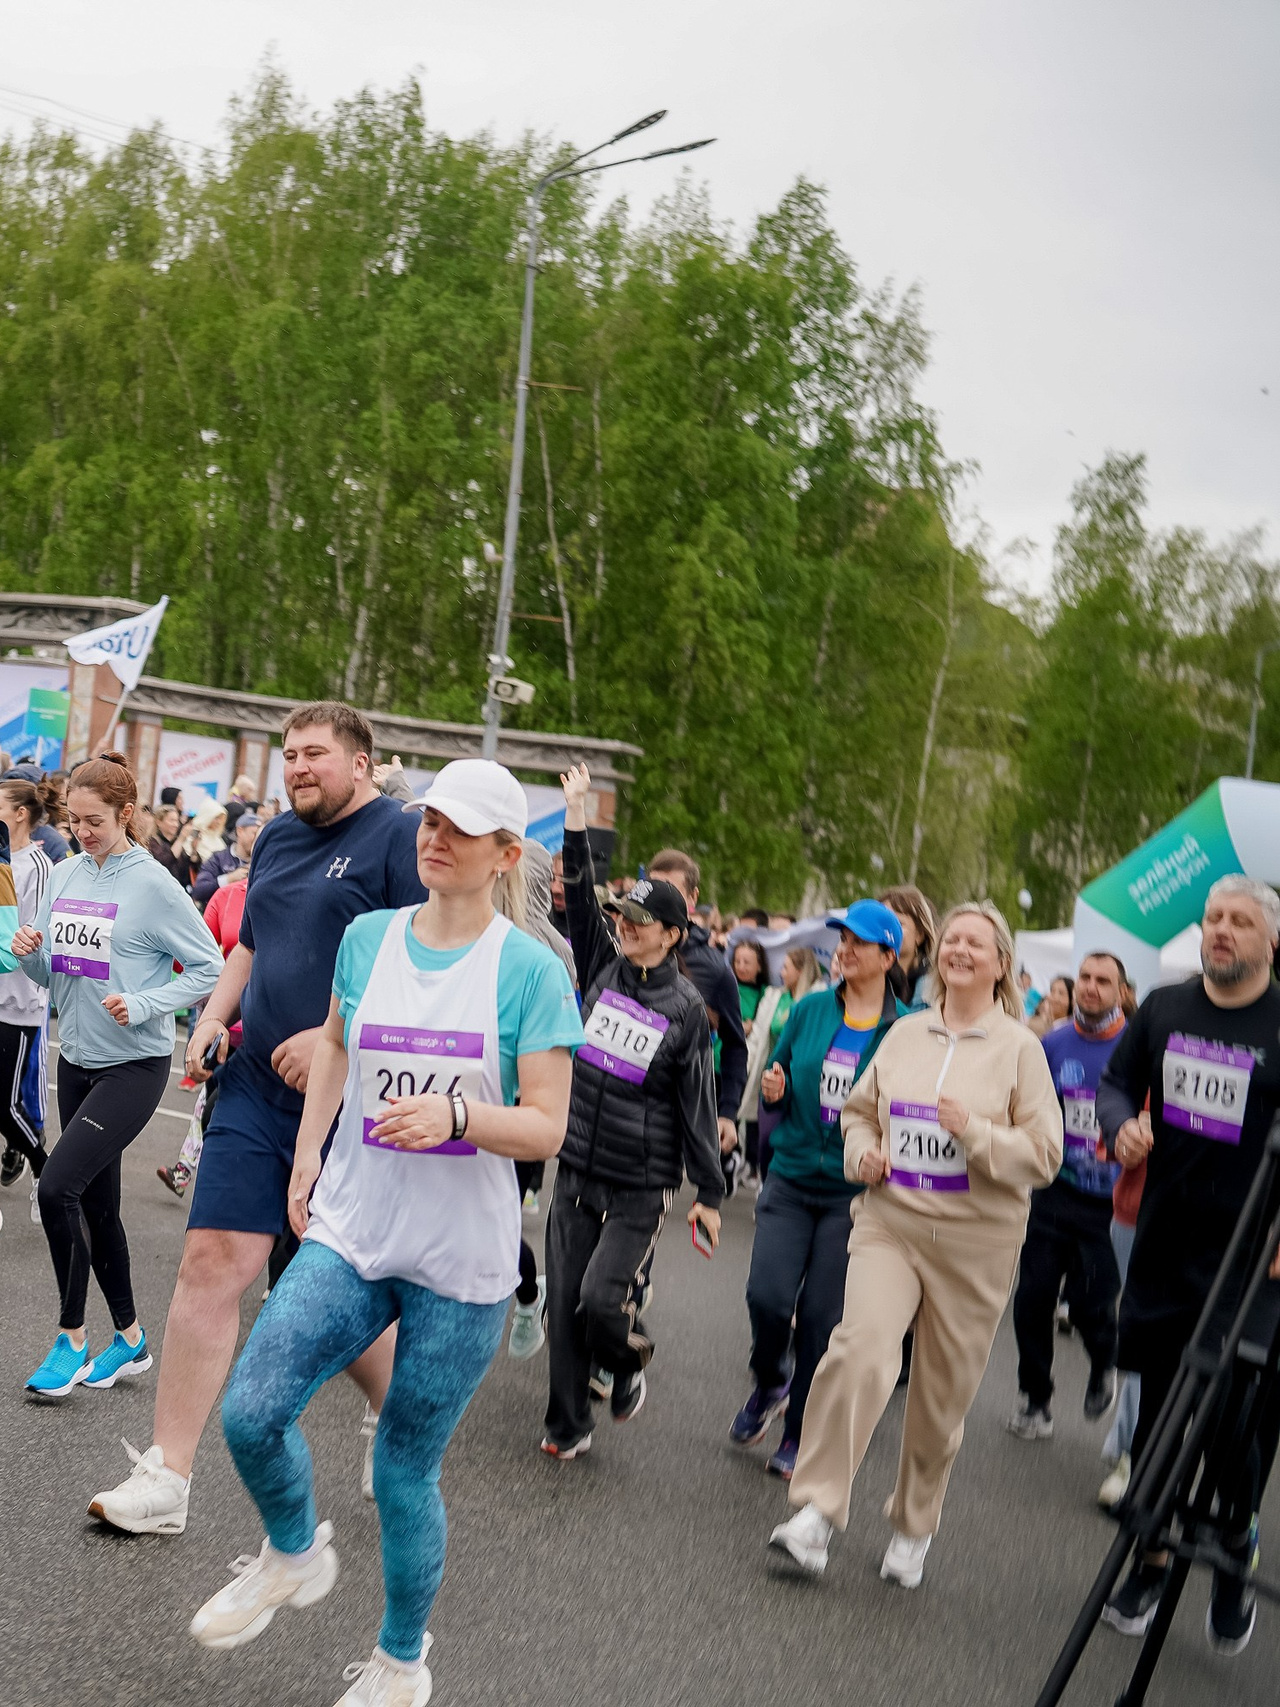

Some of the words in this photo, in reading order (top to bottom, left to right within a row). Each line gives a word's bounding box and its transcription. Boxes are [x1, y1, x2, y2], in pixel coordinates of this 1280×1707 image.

[54, 921, 102, 950] 2064
[595, 1015, 650, 1054] 2110
[1173, 1065, 1238, 1109] 2105
[899, 1130, 957, 1161] 2106
